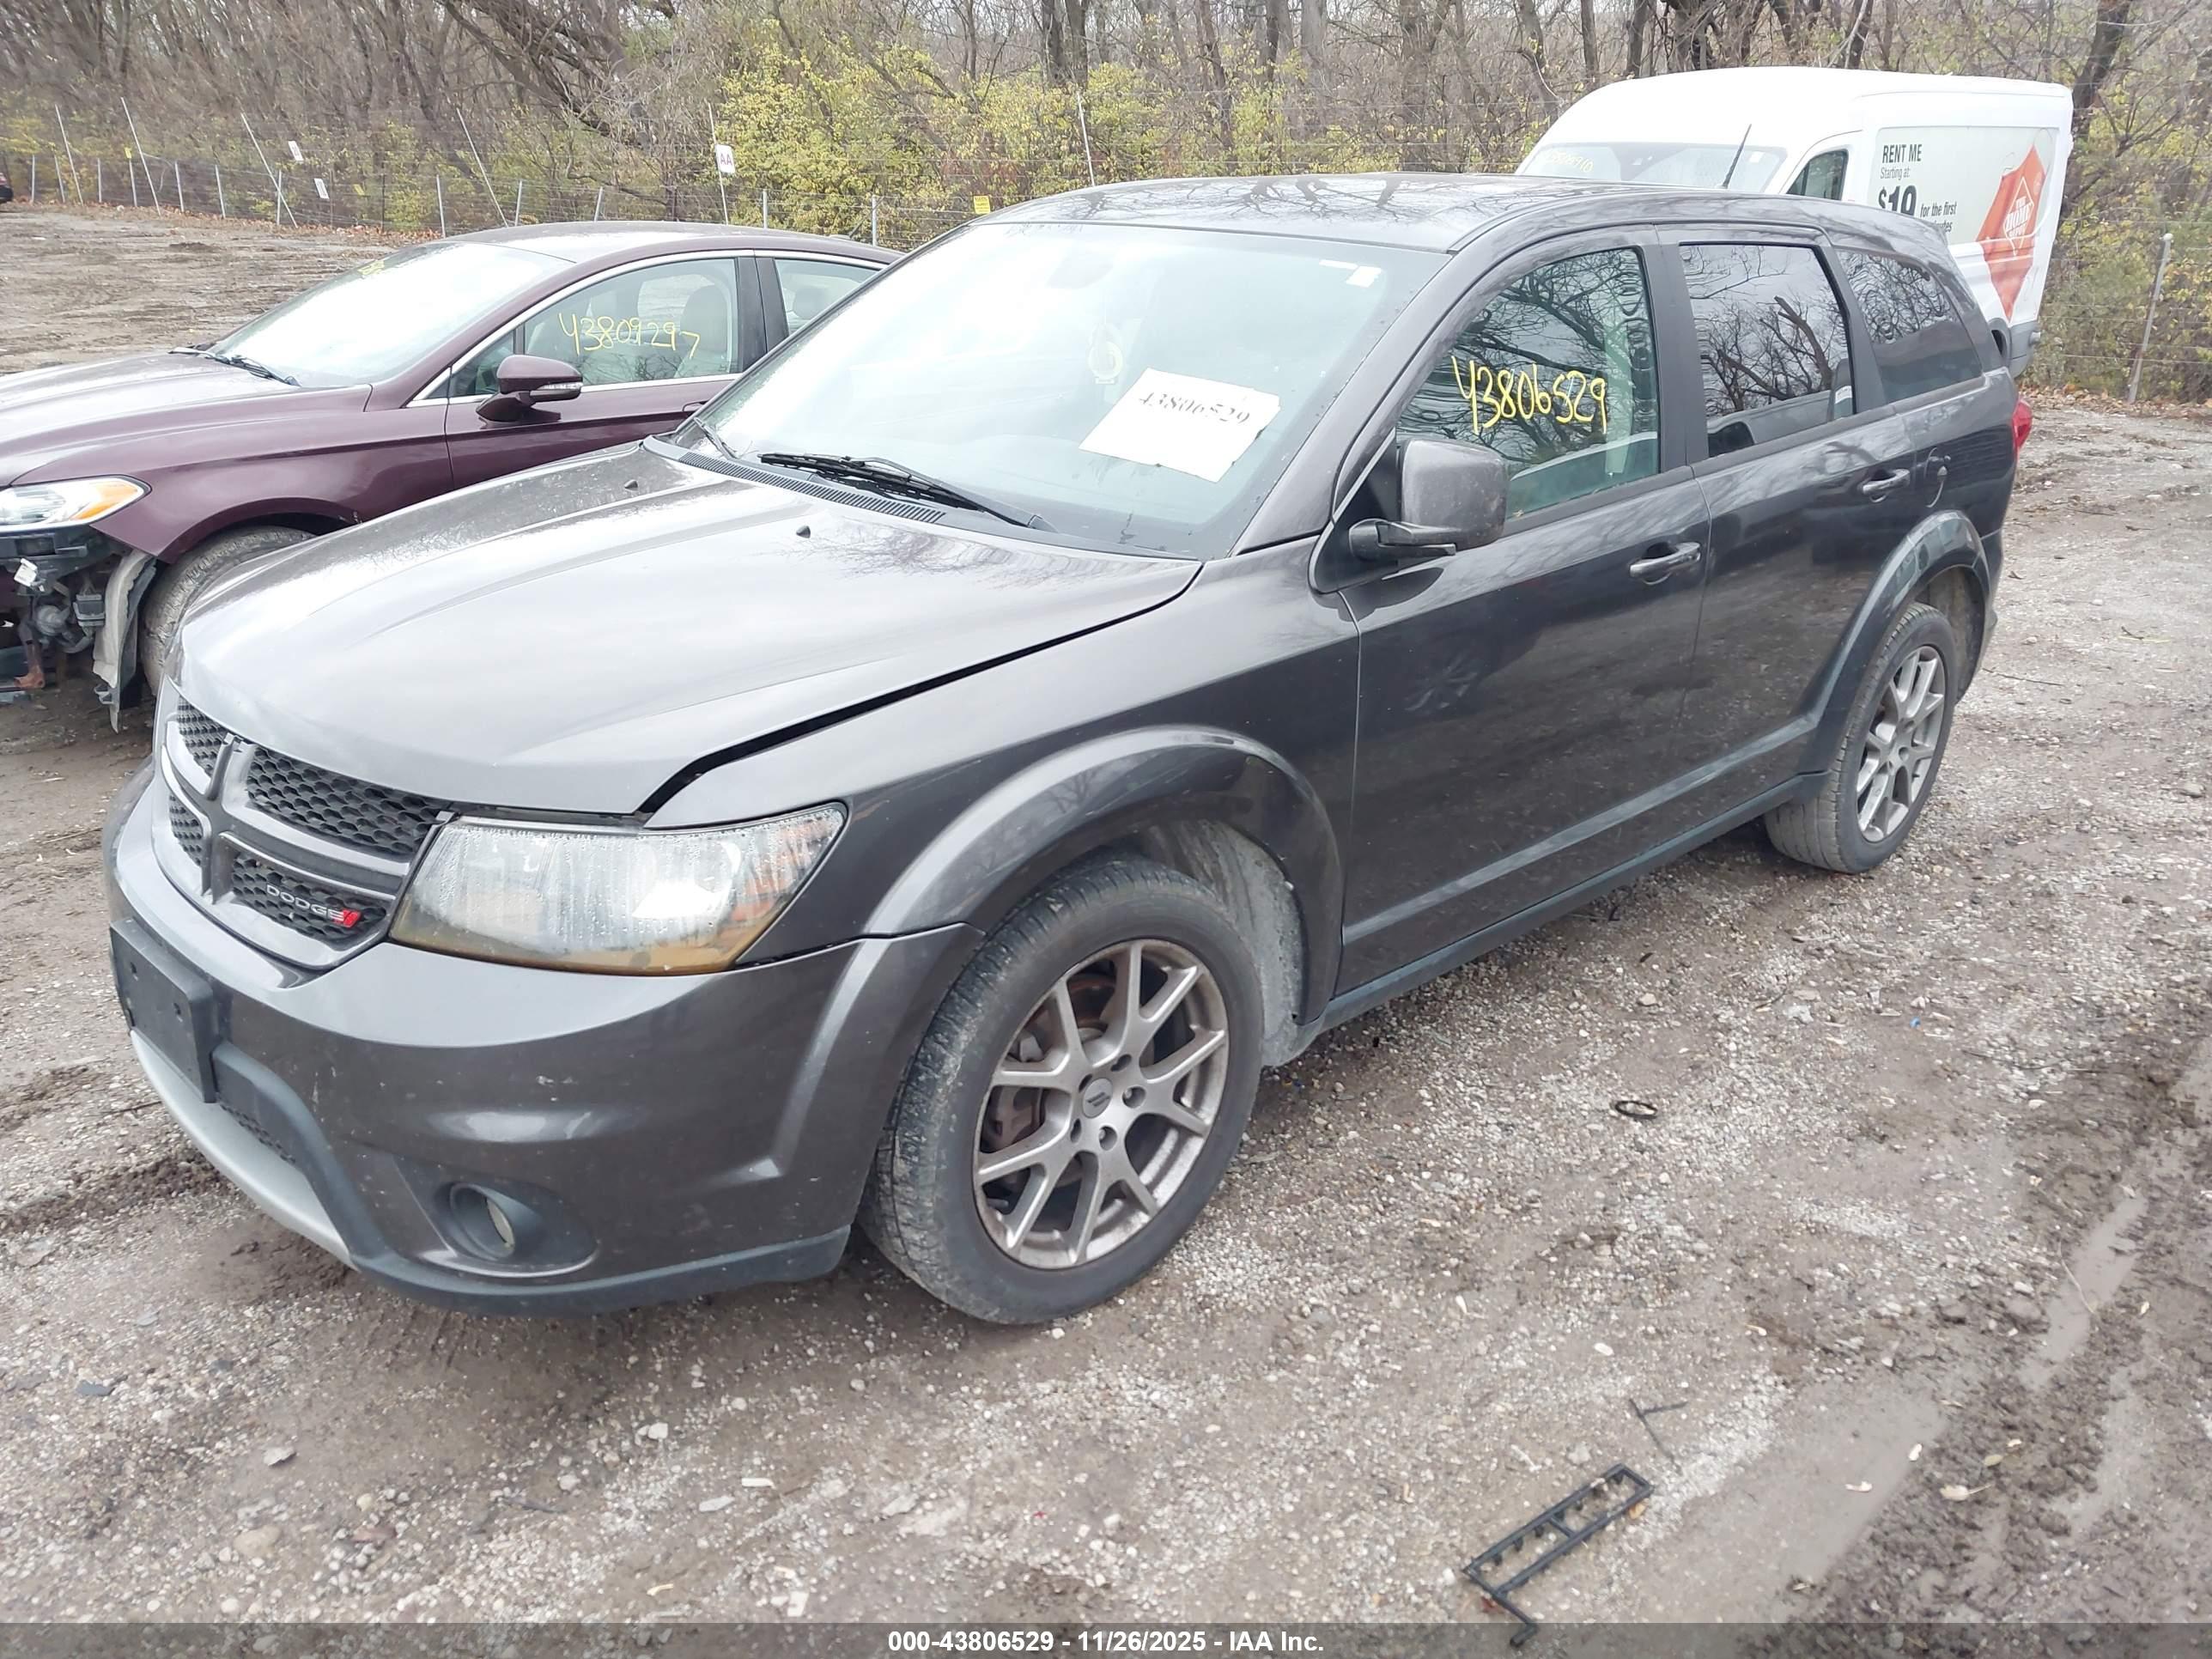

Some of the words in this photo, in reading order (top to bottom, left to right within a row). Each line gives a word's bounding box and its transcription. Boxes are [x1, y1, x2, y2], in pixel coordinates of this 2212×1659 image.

[1882, 144, 1906, 163] RENT
[1909, 144, 1923, 161] ME
[1881, 167, 1903, 180] Starting
[1920, 204, 1930, 217] for
[1931, 202, 1942, 216] the
[1942, 201, 1957, 216] first
[558, 313, 701, 360] 43809297
[1451, 356, 1607, 435] 43806529
[266, 884, 343, 922] DODGE
